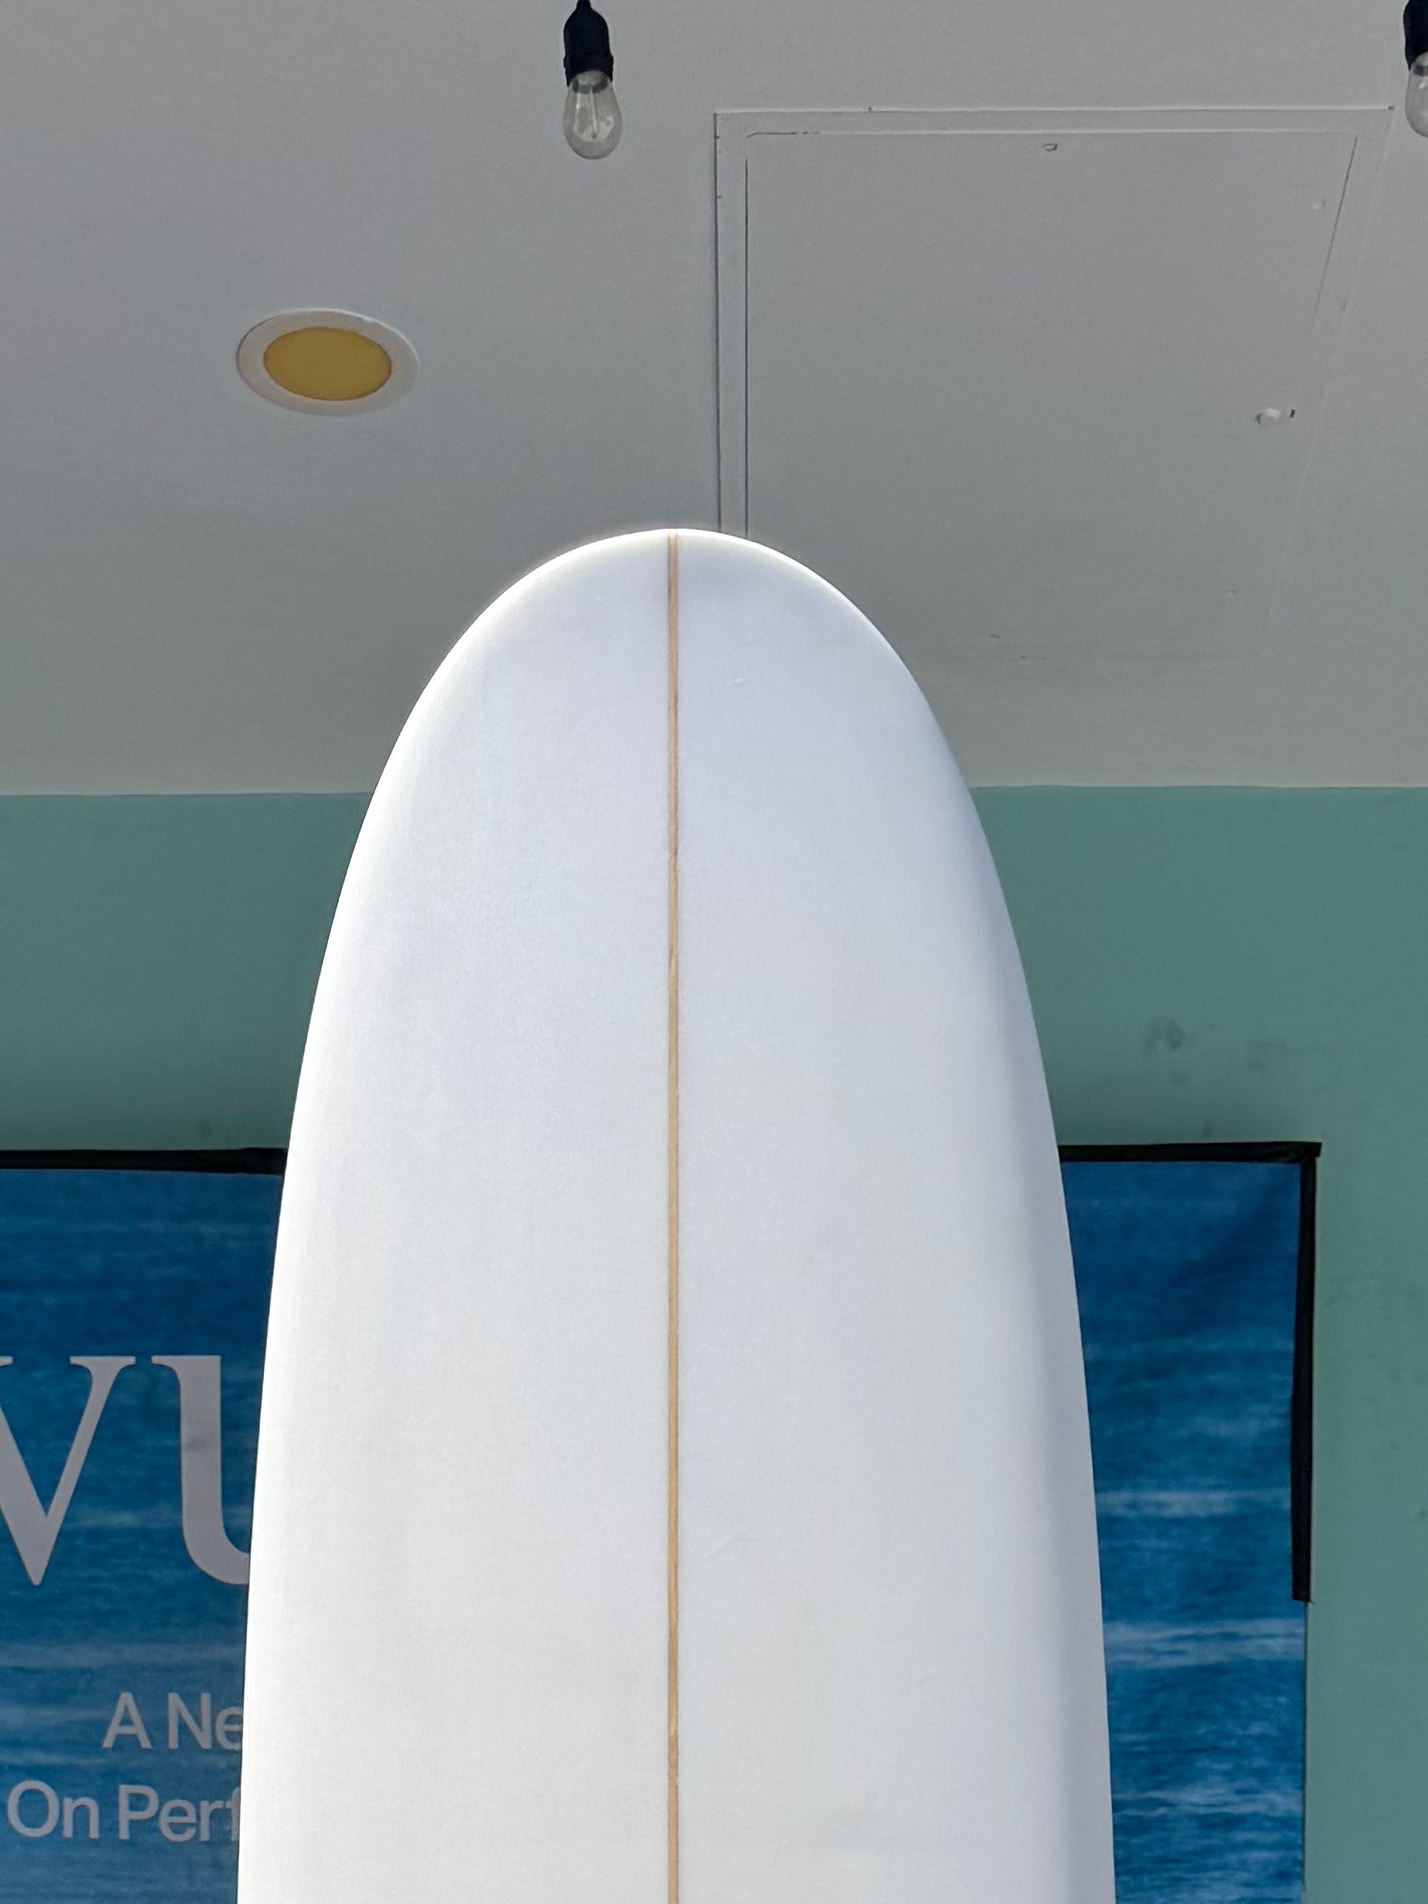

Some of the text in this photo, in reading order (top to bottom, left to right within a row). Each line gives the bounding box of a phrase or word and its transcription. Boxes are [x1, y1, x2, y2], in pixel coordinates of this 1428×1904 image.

[103, 1692, 244, 1751] A Ne
[7, 1780, 100, 1839] On
